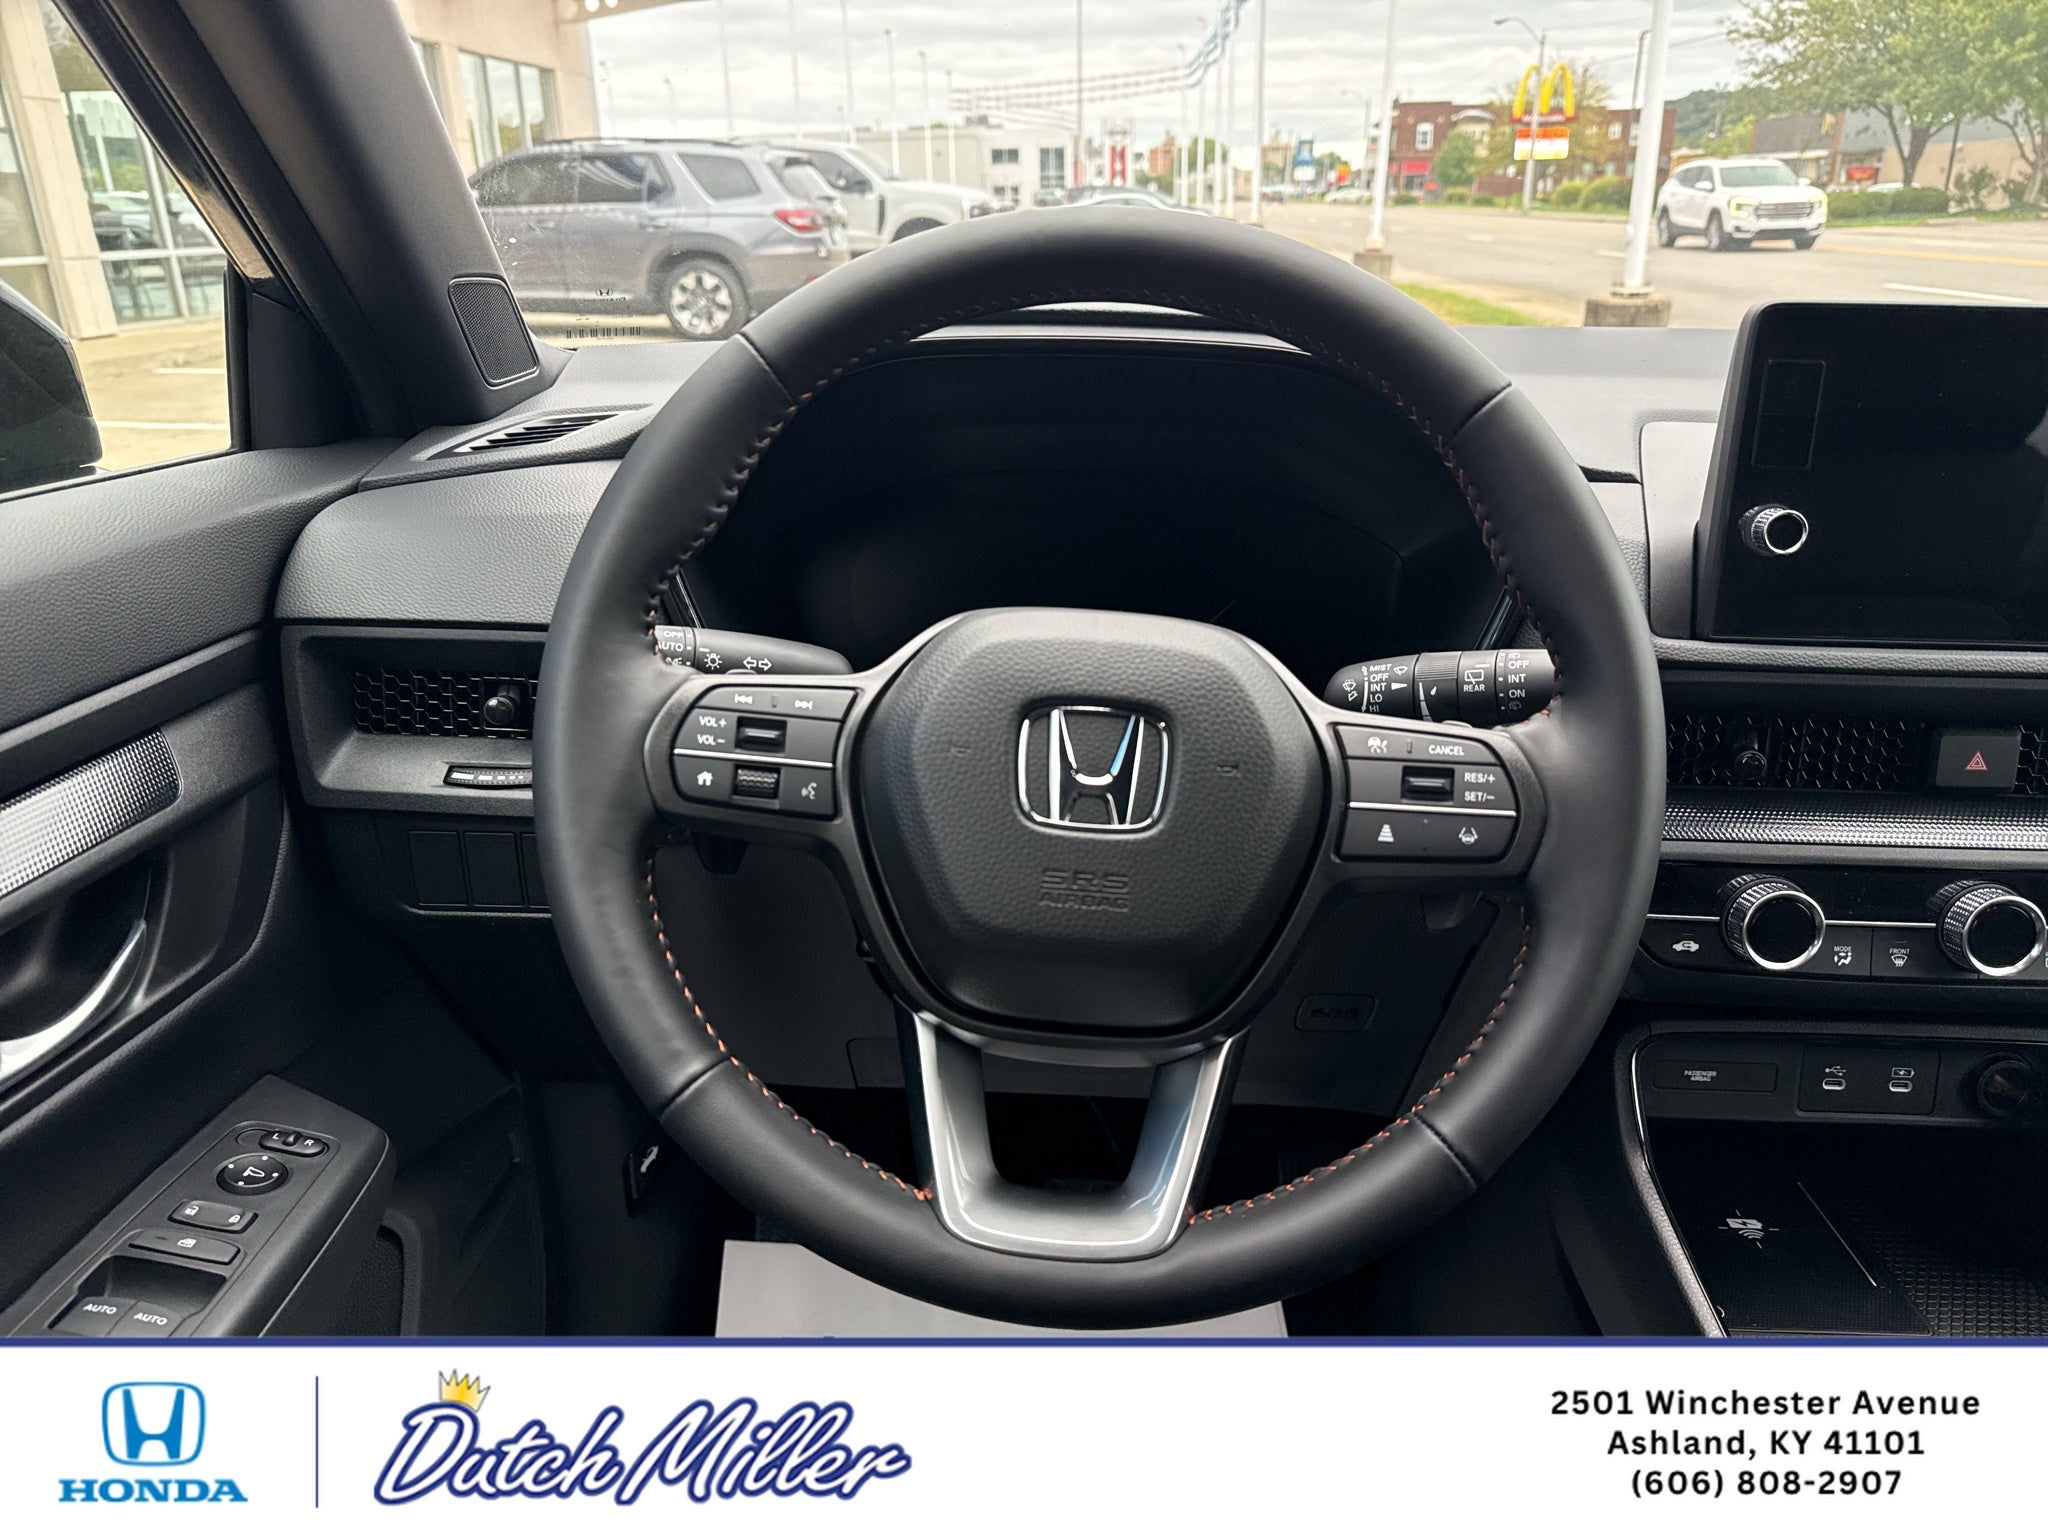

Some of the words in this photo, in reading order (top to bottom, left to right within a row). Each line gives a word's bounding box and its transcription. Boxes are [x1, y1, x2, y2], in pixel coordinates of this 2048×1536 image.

[662, 630, 684, 639] OFF
[1369, 663, 1393, 672] MIST
[1508, 659, 1530, 669] OFF
[1369, 673, 1389, 682] OFF
[1508, 674, 1527, 684] INT
[1370, 682, 1387, 692] INT
[1463, 683, 1486, 693] REAR
[1508, 688, 1526, 698] ON
[1370, 694, 1383, 703] LO
[1369, 704, 1380, 713] HI
[1428, 744, 1465, 756] CANCEL
[1464, 771, 1496, 784] RES/+
[272, 1132, 280, 1140] L
[304, 1138, 316, 1147] R
[82, 1302, 118, 1314] AUTO
[133, 1311, 168, 1326] AUTO
